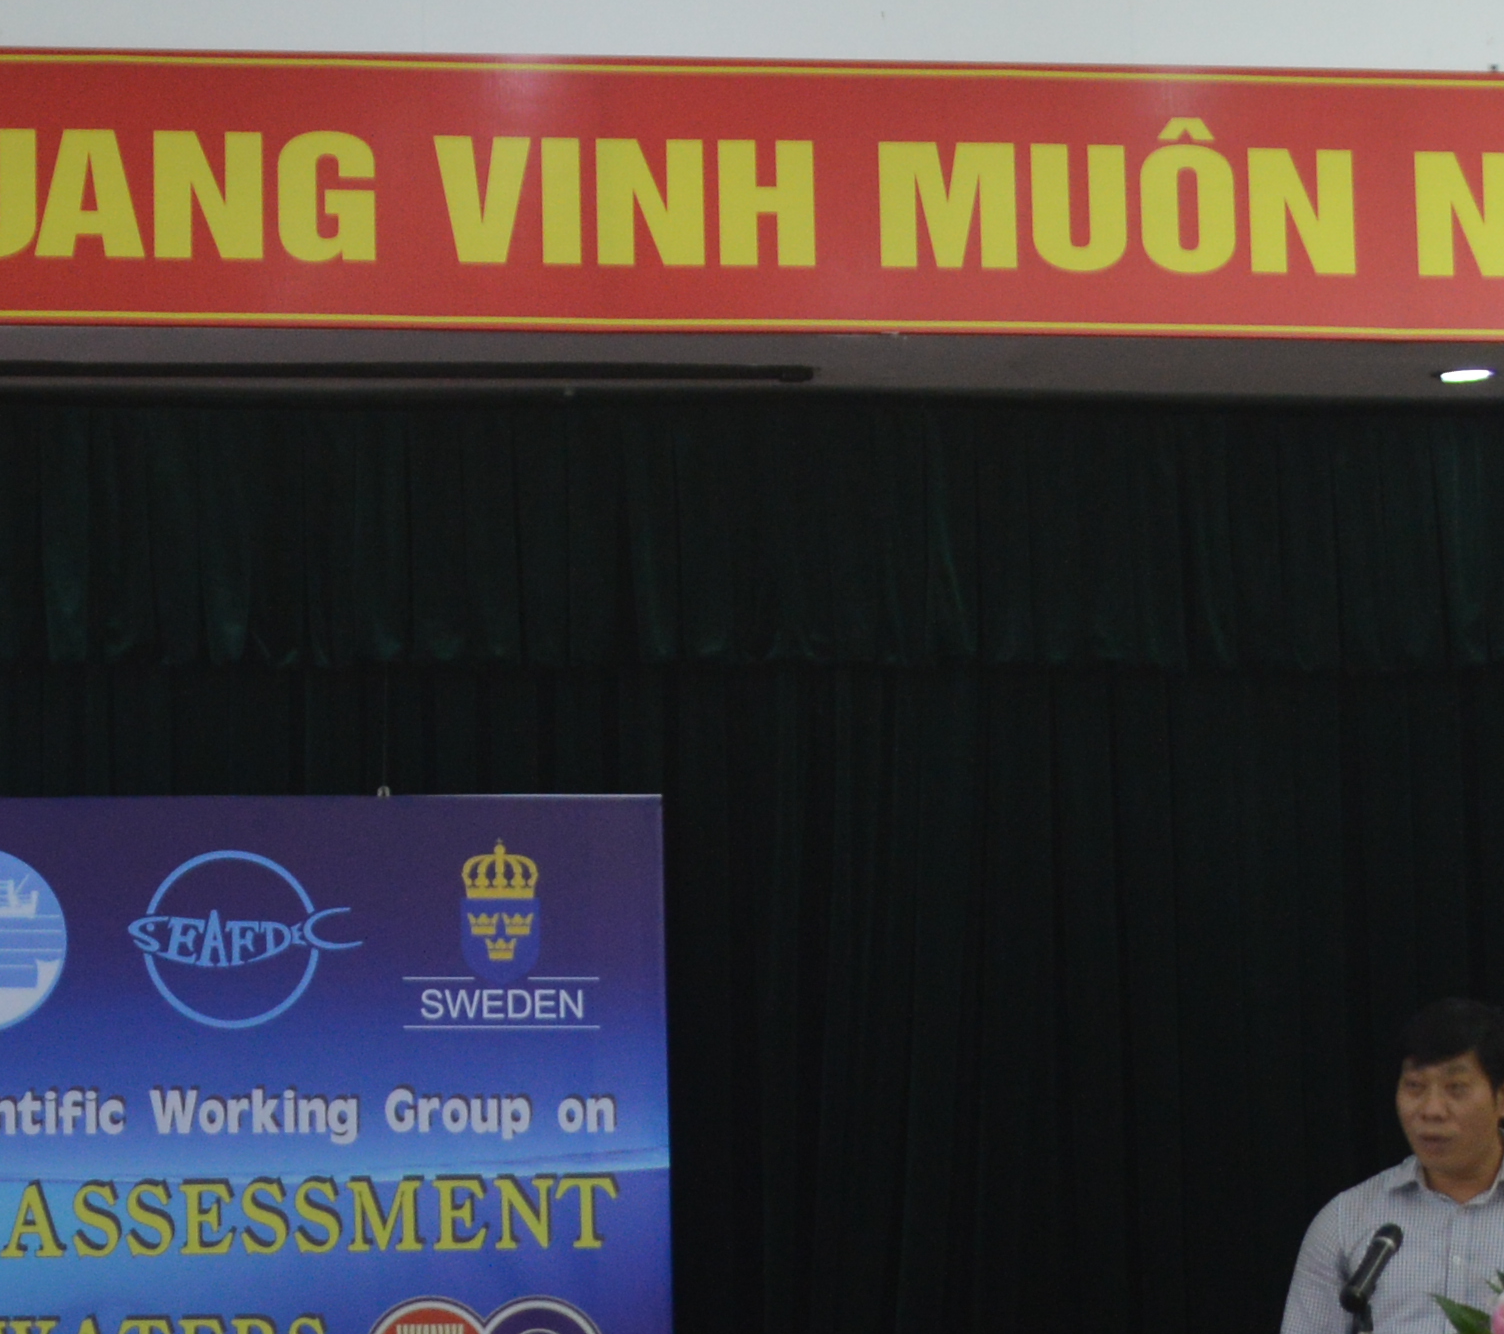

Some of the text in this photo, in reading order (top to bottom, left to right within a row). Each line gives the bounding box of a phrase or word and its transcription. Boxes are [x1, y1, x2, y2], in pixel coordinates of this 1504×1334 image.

[435, 136, 816, 266] VINH
[879, 119, 1356, 275] MUÔN
[421, 989, 583, 1019] SWEDEN
[150, 1089, 358, 1145] Working
[385, 1089, 530, 1141] Group
[558, 1098, 615, 1133] on
[1, 1176, 617, 1258] ASSESSMENT
